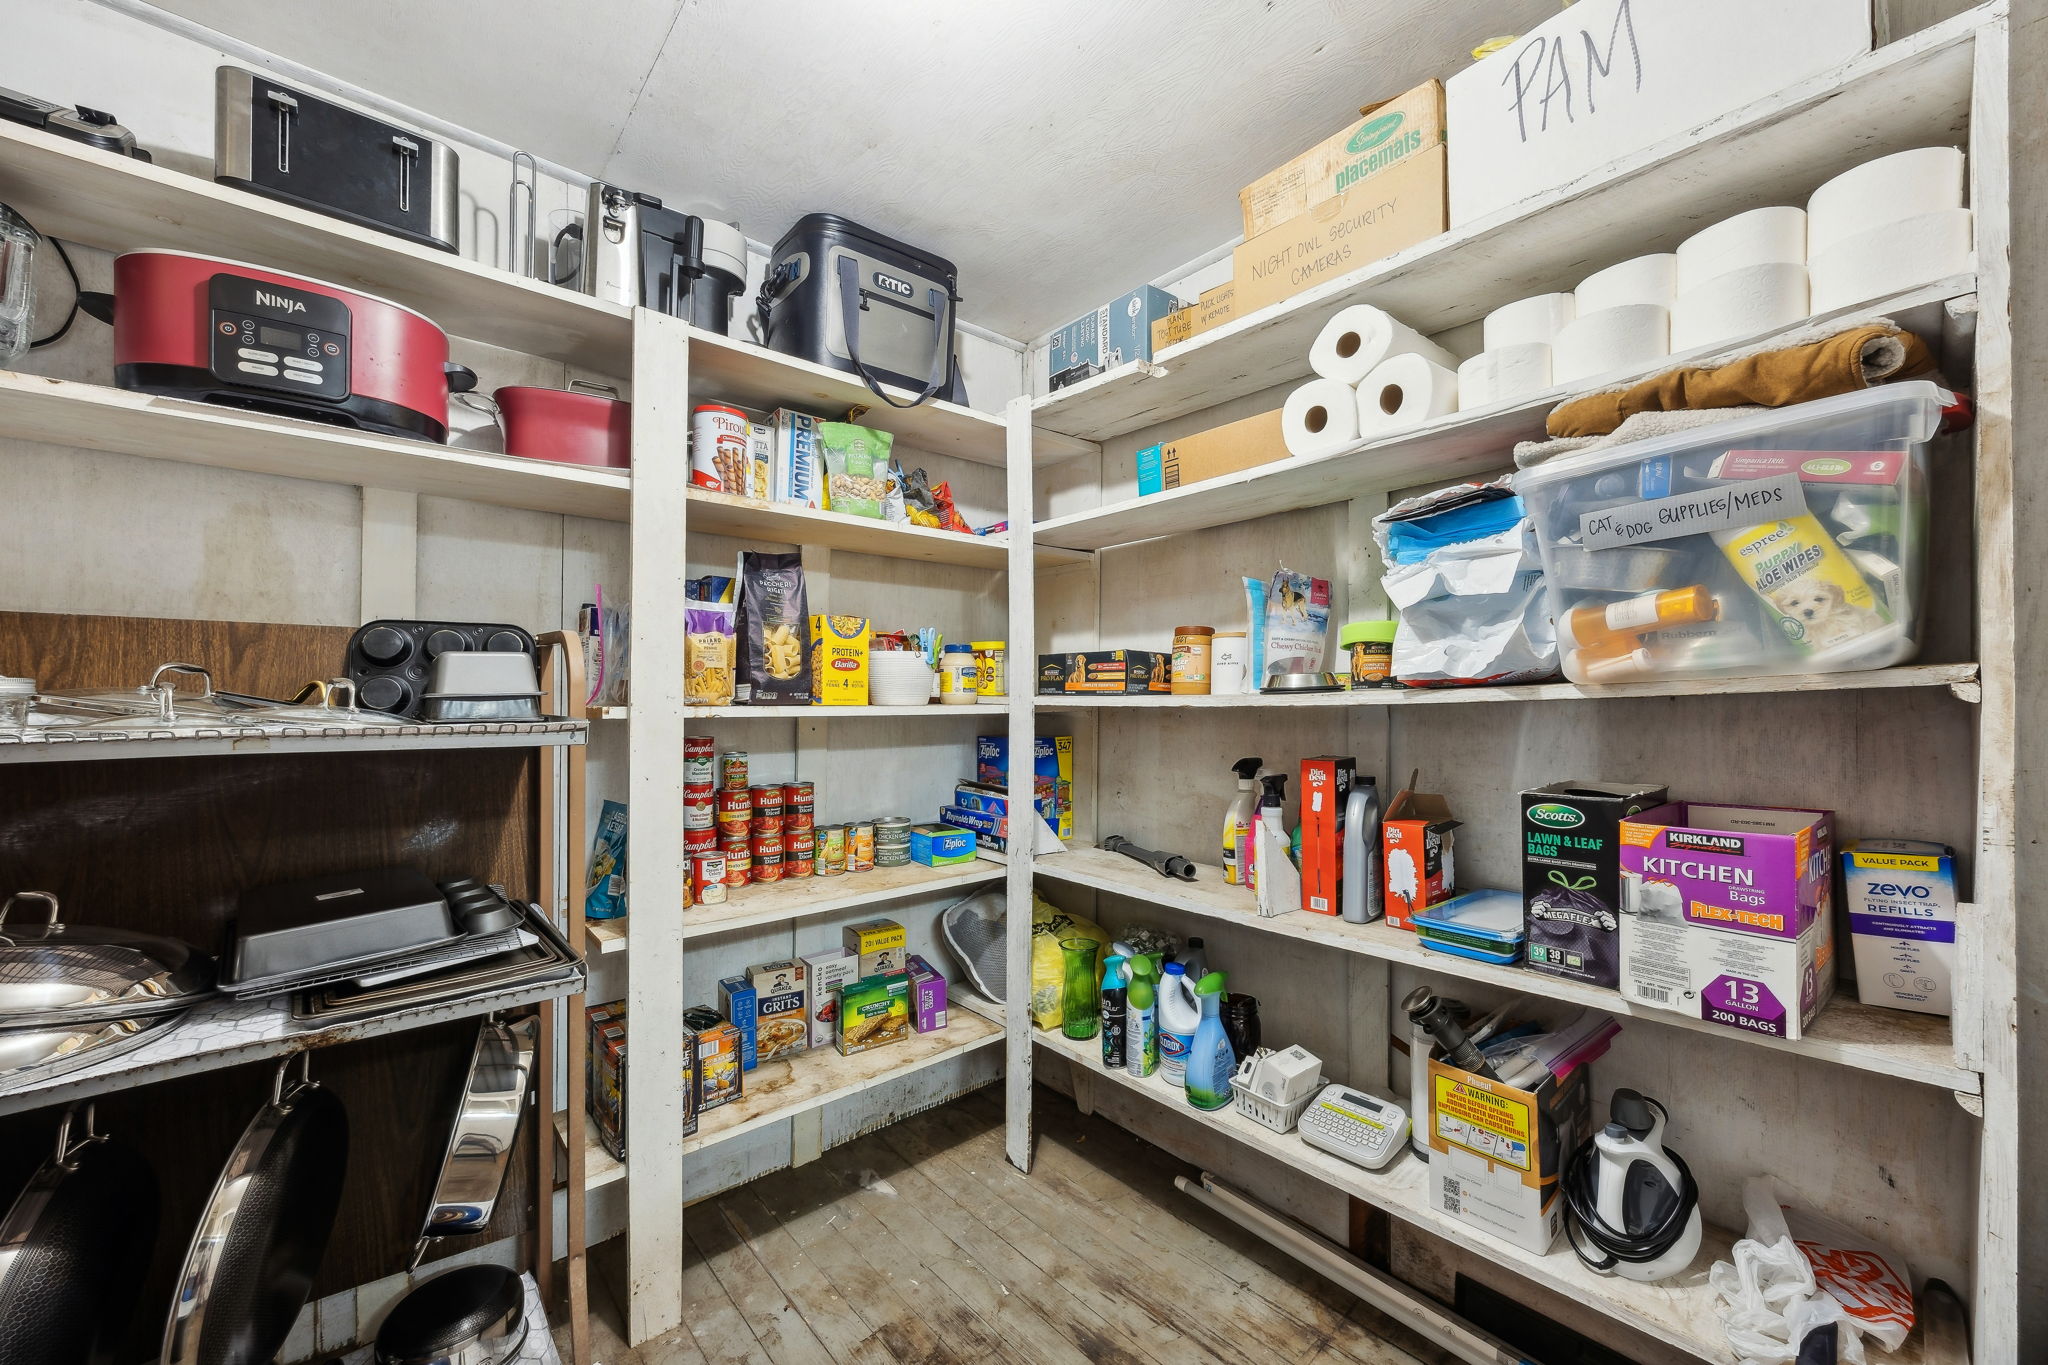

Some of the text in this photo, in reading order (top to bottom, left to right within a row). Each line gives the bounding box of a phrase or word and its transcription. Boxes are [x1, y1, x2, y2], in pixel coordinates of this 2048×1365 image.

[1501, 0, 1641, 142] PAM
[1335, 129, 1422, 194] placemats
[1252, 246, 1292, 281] NIGHT
[1297, 236, 1323, 258] OWL
[1290, 244, 1353, 286] CAMERAS
[878, 274, 911, 295] RTIC
[255, 289, 307, 314] NINJA
[1166, 310, 1185, 326] PLANT
[1101, 307, 1109, 355] STANDARD
[1173, 320, 1192, 335] TUBE
[794, 414, 812, 501] PREMIUM
[1588, 515, 1613, 536] CAT
[1625, 521, 1653, 539] DOG
[1739, 530, 1786, 557] espree
[1754, 542, 1801, 575] PUPPY
[1755, 544, 1822, 592] ALOE WIPES
[815, 616, 822, 632] 4
[831, 647, 864, 657] PROTEIN+
[1270, 641, 1293, 652] Chewy
[834, 660, 858, 670] Barilla
[842, 678, 849, 688] 4
[980, 744, 1000, 759] Ziploc
[1034, 745, 1054, 759] Ziploc
[1309, 773, 1326, 781] Devil
[1310, 768, 1325, 776] Dirt
[968, 815, 983, 828] Wrap
[1535, 807, 1578, 823] Scotts
[1386, 832, 1403, 840] Devil
[1387, 826, 1401, 835] Dirt
[943, 838, 967, 852] Ziploc
[1527, 831, 1603, 851] LAWN & LEAF
[1669, 832, 1741, 849] KIRKLAND
[1527, 843, 1558, 857] BAGS
[1862, 857, 1929, 868] VALUE PACK
[1643, 855, 1754, 887] KITCHEN
[1728, 885, 1766, 895] DRAWSTRING
[1867, 882, 1930, 899] zevo
[1729, 890, 1766, 906] Bags
[1890, 899, 1917, 907] INSECT
[1690, 900, 1784, 932] FLEX-TECH
[1867, 904, 1934, 917] REFILLS
[874, 937, 890, 946] VALUE
[890, 934, 903, 943] PACK
[1533, 945, 1545, 957] 39
[1549, 948, 1561, 960] 38
[825, 963, 838, 971] easy
[825, 965, 847, 975] oatmeal
[842, 969, 855, 978] pack
[770, 985, 793, 994] QUAKER
[1805, 968, 1814, 997] 13
[772, 994, 792, 1002] INSTANT
[1724, 980, 1759, 1004] 13
[763, 997, 801, 1014] GRITS
[861, 999, 891, 1013] CRUNCHY
[1725, 999, 1759, 1012] GALLON
[1712, 1009, 1777, 1033] 200 BAGS
[1160, 1038, 1180, 1052] CLOROX
[1446, 1090, 1467, 1103] UNPLUG
[1467, 1097, 1488, 1111] BEFORE
[1467, 1087, 1509, 1109] WARNING:
[1446, 1098, 1515, 1127] ADDING WATER WITHOUT
[1472, 1113, 1484, 1123] CAN
[1484, 1117, 1504, 1132] CAUSE
